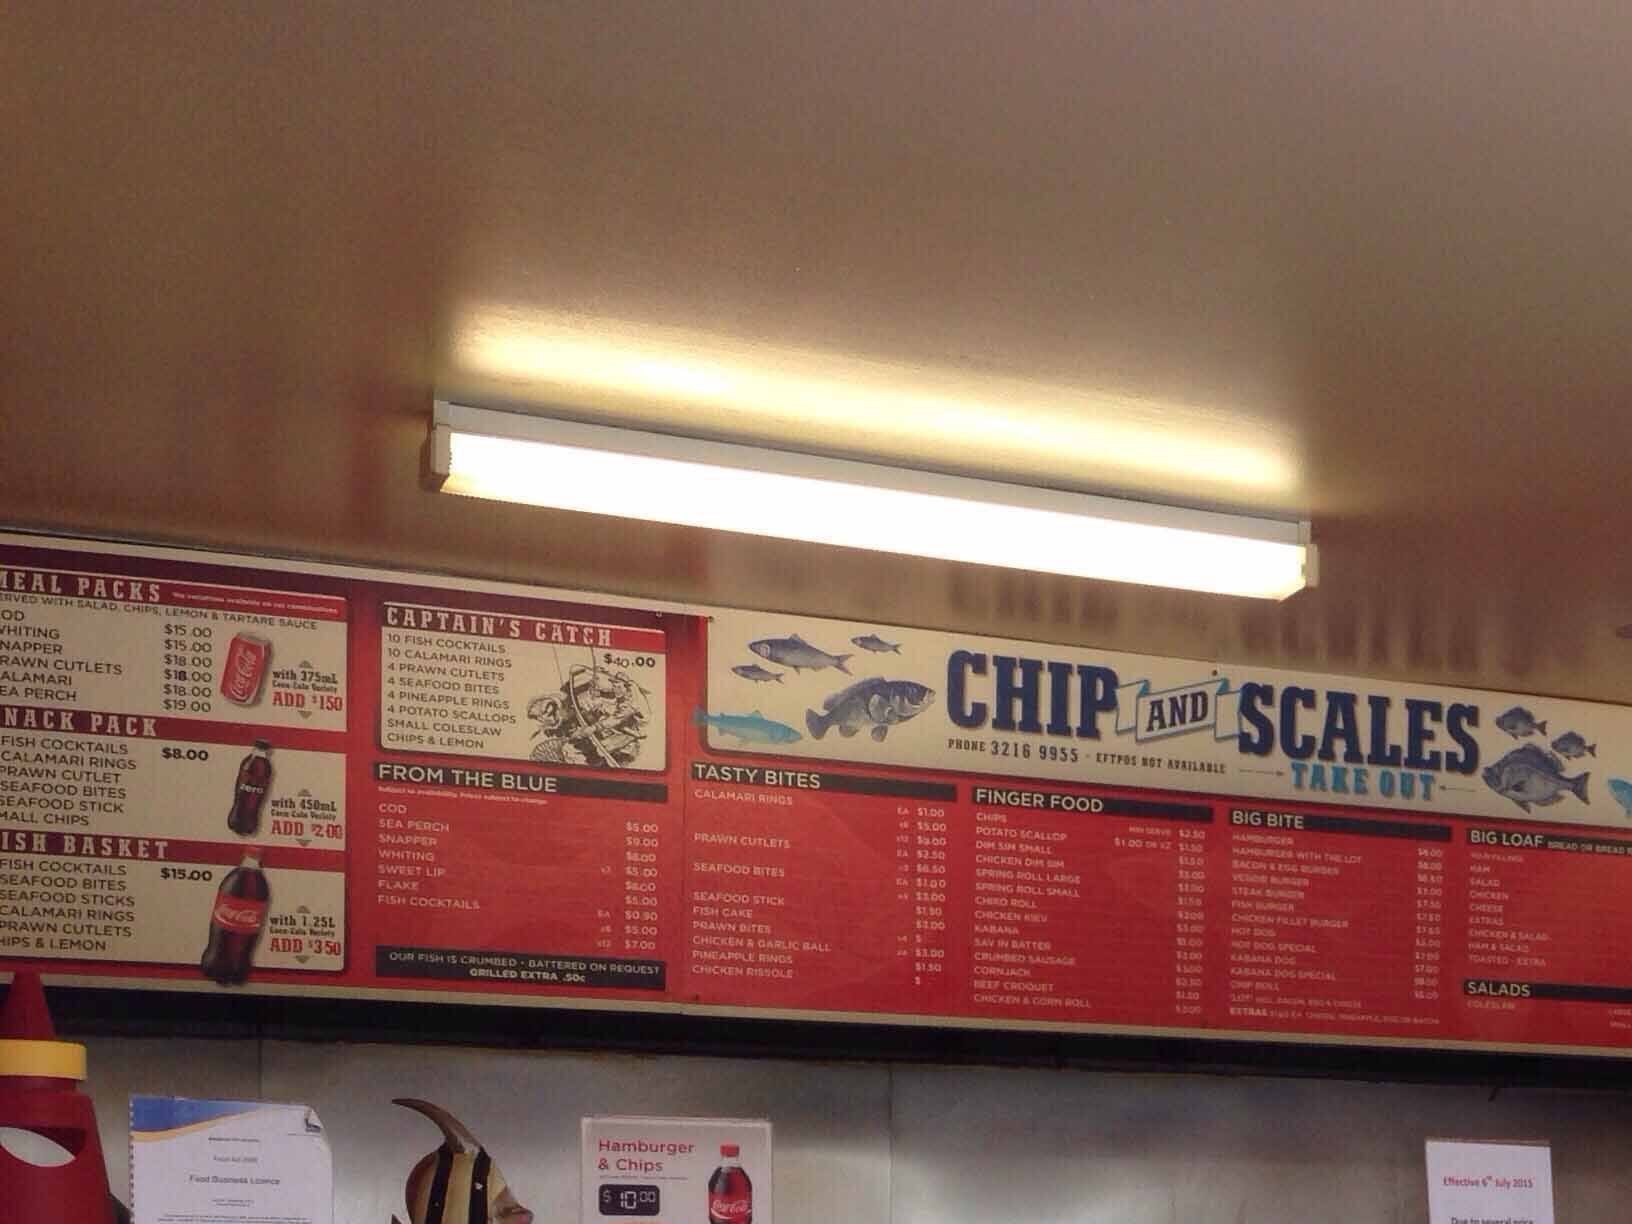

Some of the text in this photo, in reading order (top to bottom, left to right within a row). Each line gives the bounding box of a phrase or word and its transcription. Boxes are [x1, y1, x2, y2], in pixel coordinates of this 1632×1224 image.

[77, 577, 161, 602] PACKS
[41, 596, 74, 607] WITH
[165, 608, 208, 620] LEMON
[222, 613, 275, 627] TARTARE
[279, 619, 318, 630] SAUCE
[386, 606, 611, 647] CAPTAIN'S CATCH
[404, 635, 506, 654] FISH COCKTAILS
[405, 649, 512, 668] CALAMARI RINGS
[53, 659, 123, 676] CUTLETS
[399, 663, 505, 682] PRAWN CUTLETS
[24, 687, 77, 702] PERCH
[399, 677, 499, 695] SEAFOOD BITES
[272, 692, 305, 708] ADD
[399, 691, 510, 710] PINEAPPLE RINGS
[399, 705, 517, 724] POTATO SCALLOPS
[947, 649, 1480, 774] CHIP AND SCALES
[5, 707, 157, 737] NACK PACK
[388, 718, 502, 736] SMALL COLESLAW
[1, 735, 128, 755] FISH COCKTAILS
[387, 732, 484, 749] CHIPS LEMON
[1, 751, 137, 770] CALAMARI RINGS
[161, 747, 209, 761] $8.00
[948, 738, 1227, 774] PHONE 3216 9955 EFTPOS NOT AVAILABLE
[0, 766, 121, 785] PRAWN CUTLET
[378, 764, 558, 793] FROM THE BLUE
[694, 763, 821, 789] TASTY BITES
[1290, 760, 1437, 801] TAKE OUT
[0, 781, 127, 800] SEAFOOD BITES
[694, 789, 793, 806] CALAMARI RINGS
[0, 795, 124, 814] SEAFOOD STICK
[378, 803, 408, 814] COD
[975, 788, 1104, 813] FINGER FOOD
[43, 813, 90, 826] CHIPS
[378, 818, 450, 832] SEA PERCH
[976, 812, 1008, 824] CHIPS
[1232, 811, 1305, 829] BIG BITE
[271, 820, 304, 836] ADD
[1, 831, 168, 860] ISH BASKET
[378, 833, 437, 846] SNAPPER
[1470, 830, 1544, 847] BIG LOAF
[378, 849, 435, 862] WHITING
[0, 859, 127, 876] FISH COCKTAILS
[160, 867, 213, 882] $15.00
[694, 862, 751, 875] SEAFOOD
[0, 874, 127, 892] SEAFOOD BITES
[378, 879, 419, 890] FLAKE
[80, 893, 135, 907] STICKS
[410, 897, 480, 910] COCKTAILS
[87, 909, 135, 922] RINGS
[62, 923, 133, 938] CUTLETS
[50, 939, 107, 951] LEMON
[270, 938, 303, 953] ADD
[529, 959, 586, 971] BATTERED
[470, 968, 558, 980] GRILLED EXTRA
[1467, 981, 1531, 997] SALADS
[598, 1139, 695, 1155] Hamburger
[598, 1158, 664, 1173] & Chips
